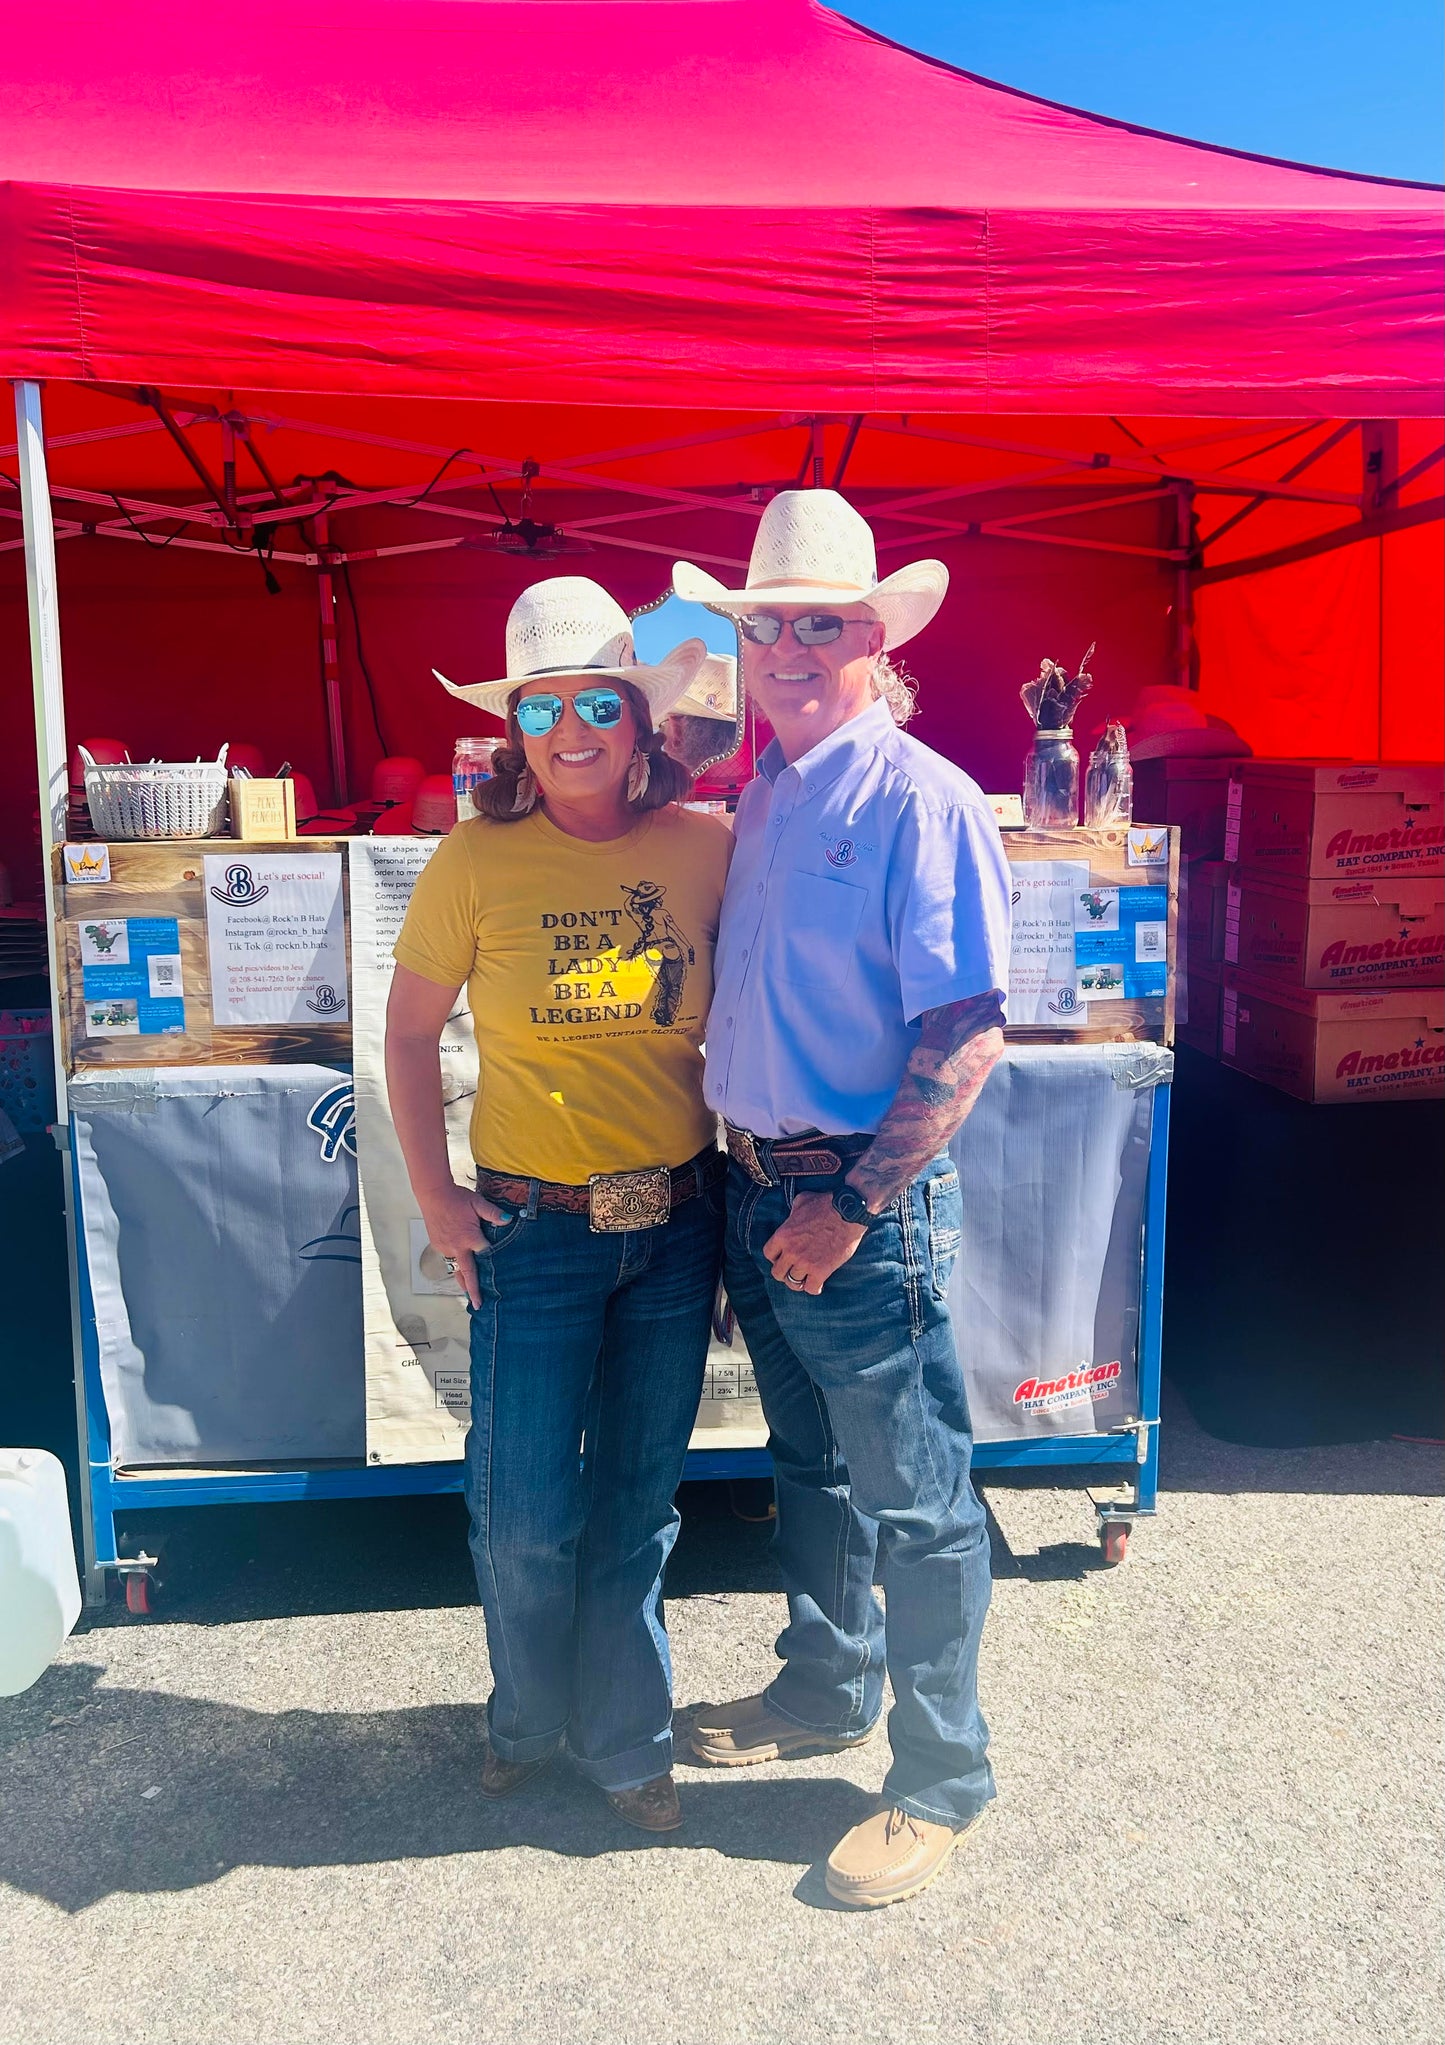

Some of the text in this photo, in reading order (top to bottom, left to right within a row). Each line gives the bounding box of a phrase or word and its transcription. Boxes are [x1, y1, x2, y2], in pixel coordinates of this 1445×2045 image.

[1337, 772, 1379, 784] American
[1325, 826, 1445, 859] America
[392, 847, 419, 855] shapes
[373, 858, 406, 866] personal
[1336, 856, 1360, 868] HAT
[1362, 848, 1424, 864] COMPANY,
[257, 872, 325, 882] Let's get social!
[1012, 878, 1074, 889] Let's get social!
[1332, 884, 1374, 896] American
[375, 892, 411, 902] Company
[272, 915, 299, 923] Rock'n
[541, 909, 622, 929] DON'T
[1013, 920, 1020, 929] @
[225, 927, 328, 938] Instagram @rockn_b_hats
[1016, 932, 1073, 941] @rockn_b_hats
[228, 942, 242, 951] Tik
[244, 942, 261, 951] Tok
[263, 943, 273, 952] @
[553, 934, 616, 951] BE A
[1012, 945, 1021, 955] @
[547, 956, 623, 976] LADY
[1330, 966, 1354, 978] HAT
[1357, 958, 1418, 974] COMPANY,
[246, 985, 272, 993] featured
[553, 981, 618, 1000] BE A
[1340, 998, 1384, 1010] American
[528, 1003, 642, 1025] LEGEND
[562, 1033, 602, 1042] LEGEND
[606, 1029, 649, 1038] VINTAGE
[1346, 1076, 1371, 1088] HAT
[1373, 1067, 1434, 1084] COMPANY,
[1014, 1362, 1120, 1403] American
[1023, 1380, 1116, 1410] HAT COMPANY, INC.
